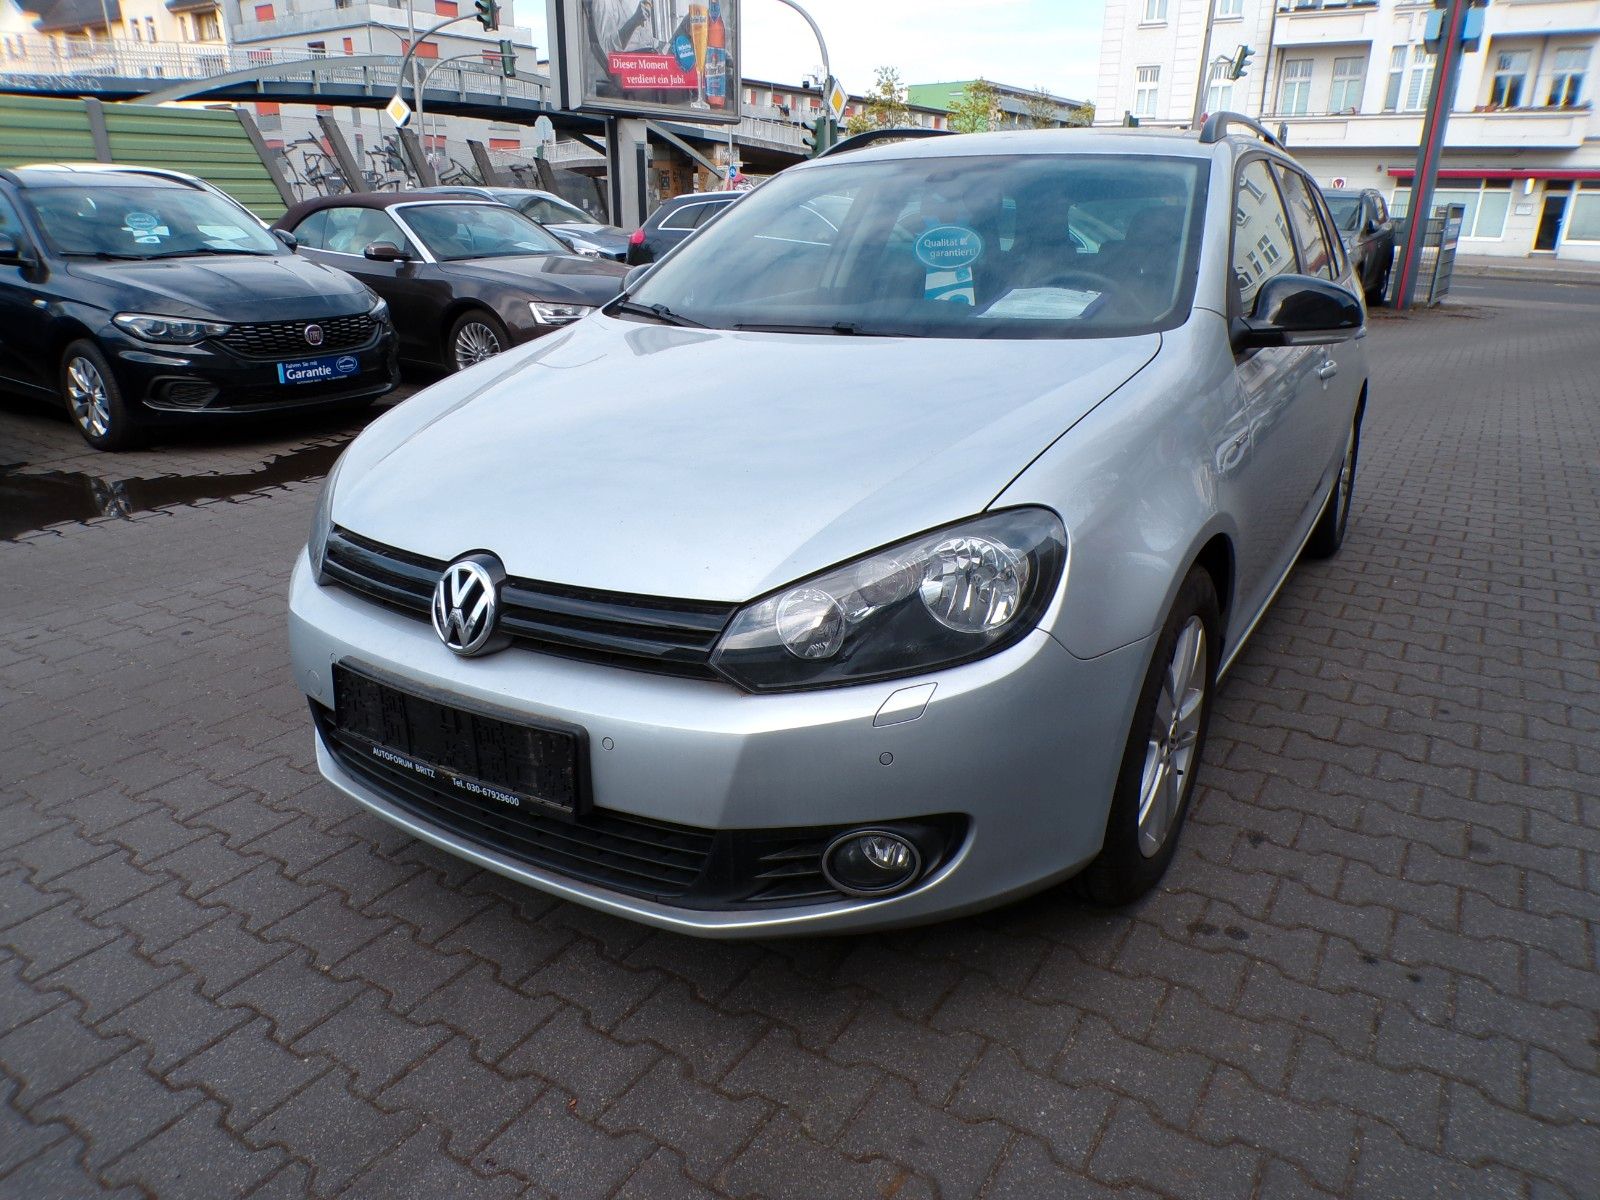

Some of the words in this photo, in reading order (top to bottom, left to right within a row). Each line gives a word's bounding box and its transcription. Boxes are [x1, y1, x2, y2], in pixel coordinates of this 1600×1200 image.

[613, 58, 637, 69] Dieser
[638, 60, 668, 70] Moment
[627, 74, 656, 84] verdient
[670, 75, 686, 86] Jubi.
[286, 364, 332, 380] Garantie
[373, 746, 414, 770] AUTOFORUM
[415, 763, 436, 779] BRITZ
[452, 777, 466, 789] Tel.
[466, 782, 520, 807] 030-67929600
